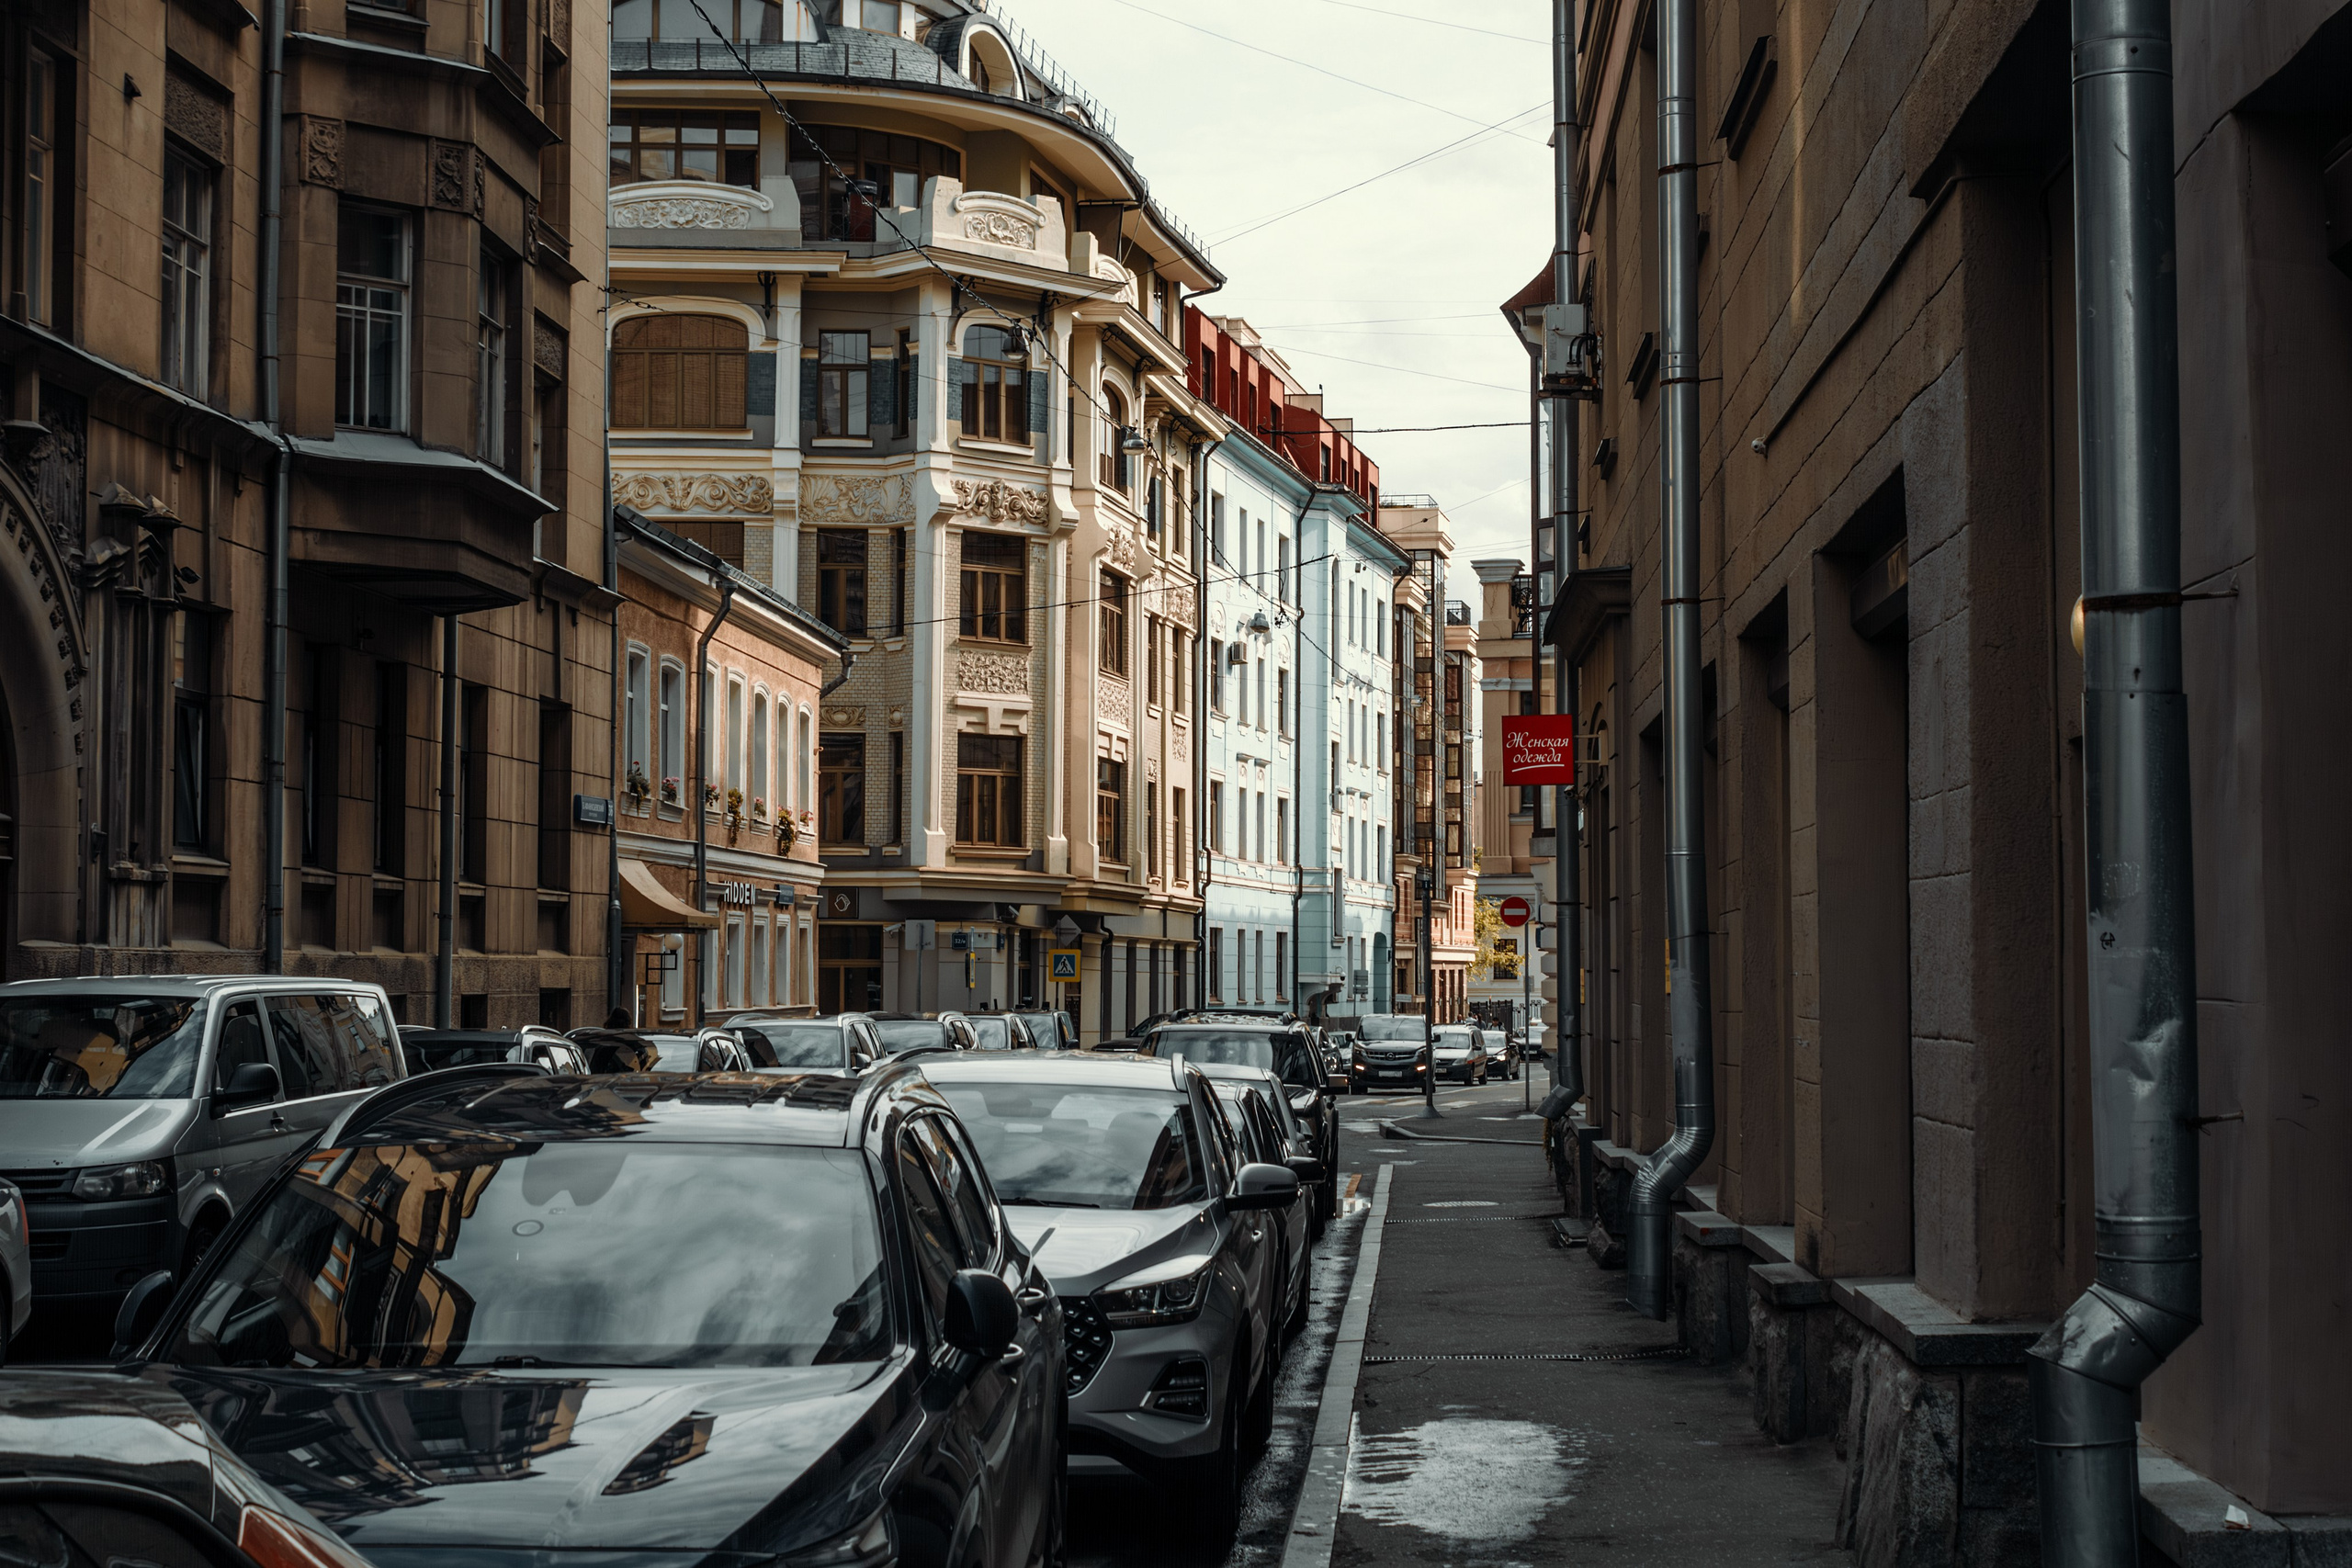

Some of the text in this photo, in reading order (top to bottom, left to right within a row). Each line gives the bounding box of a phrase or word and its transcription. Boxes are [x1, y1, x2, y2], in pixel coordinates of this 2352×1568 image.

[1506, 731, 1569, 749] Женская
[1512, 748, 1562, 763] одежда
[724, 881, 756, 905] HIDDEN
